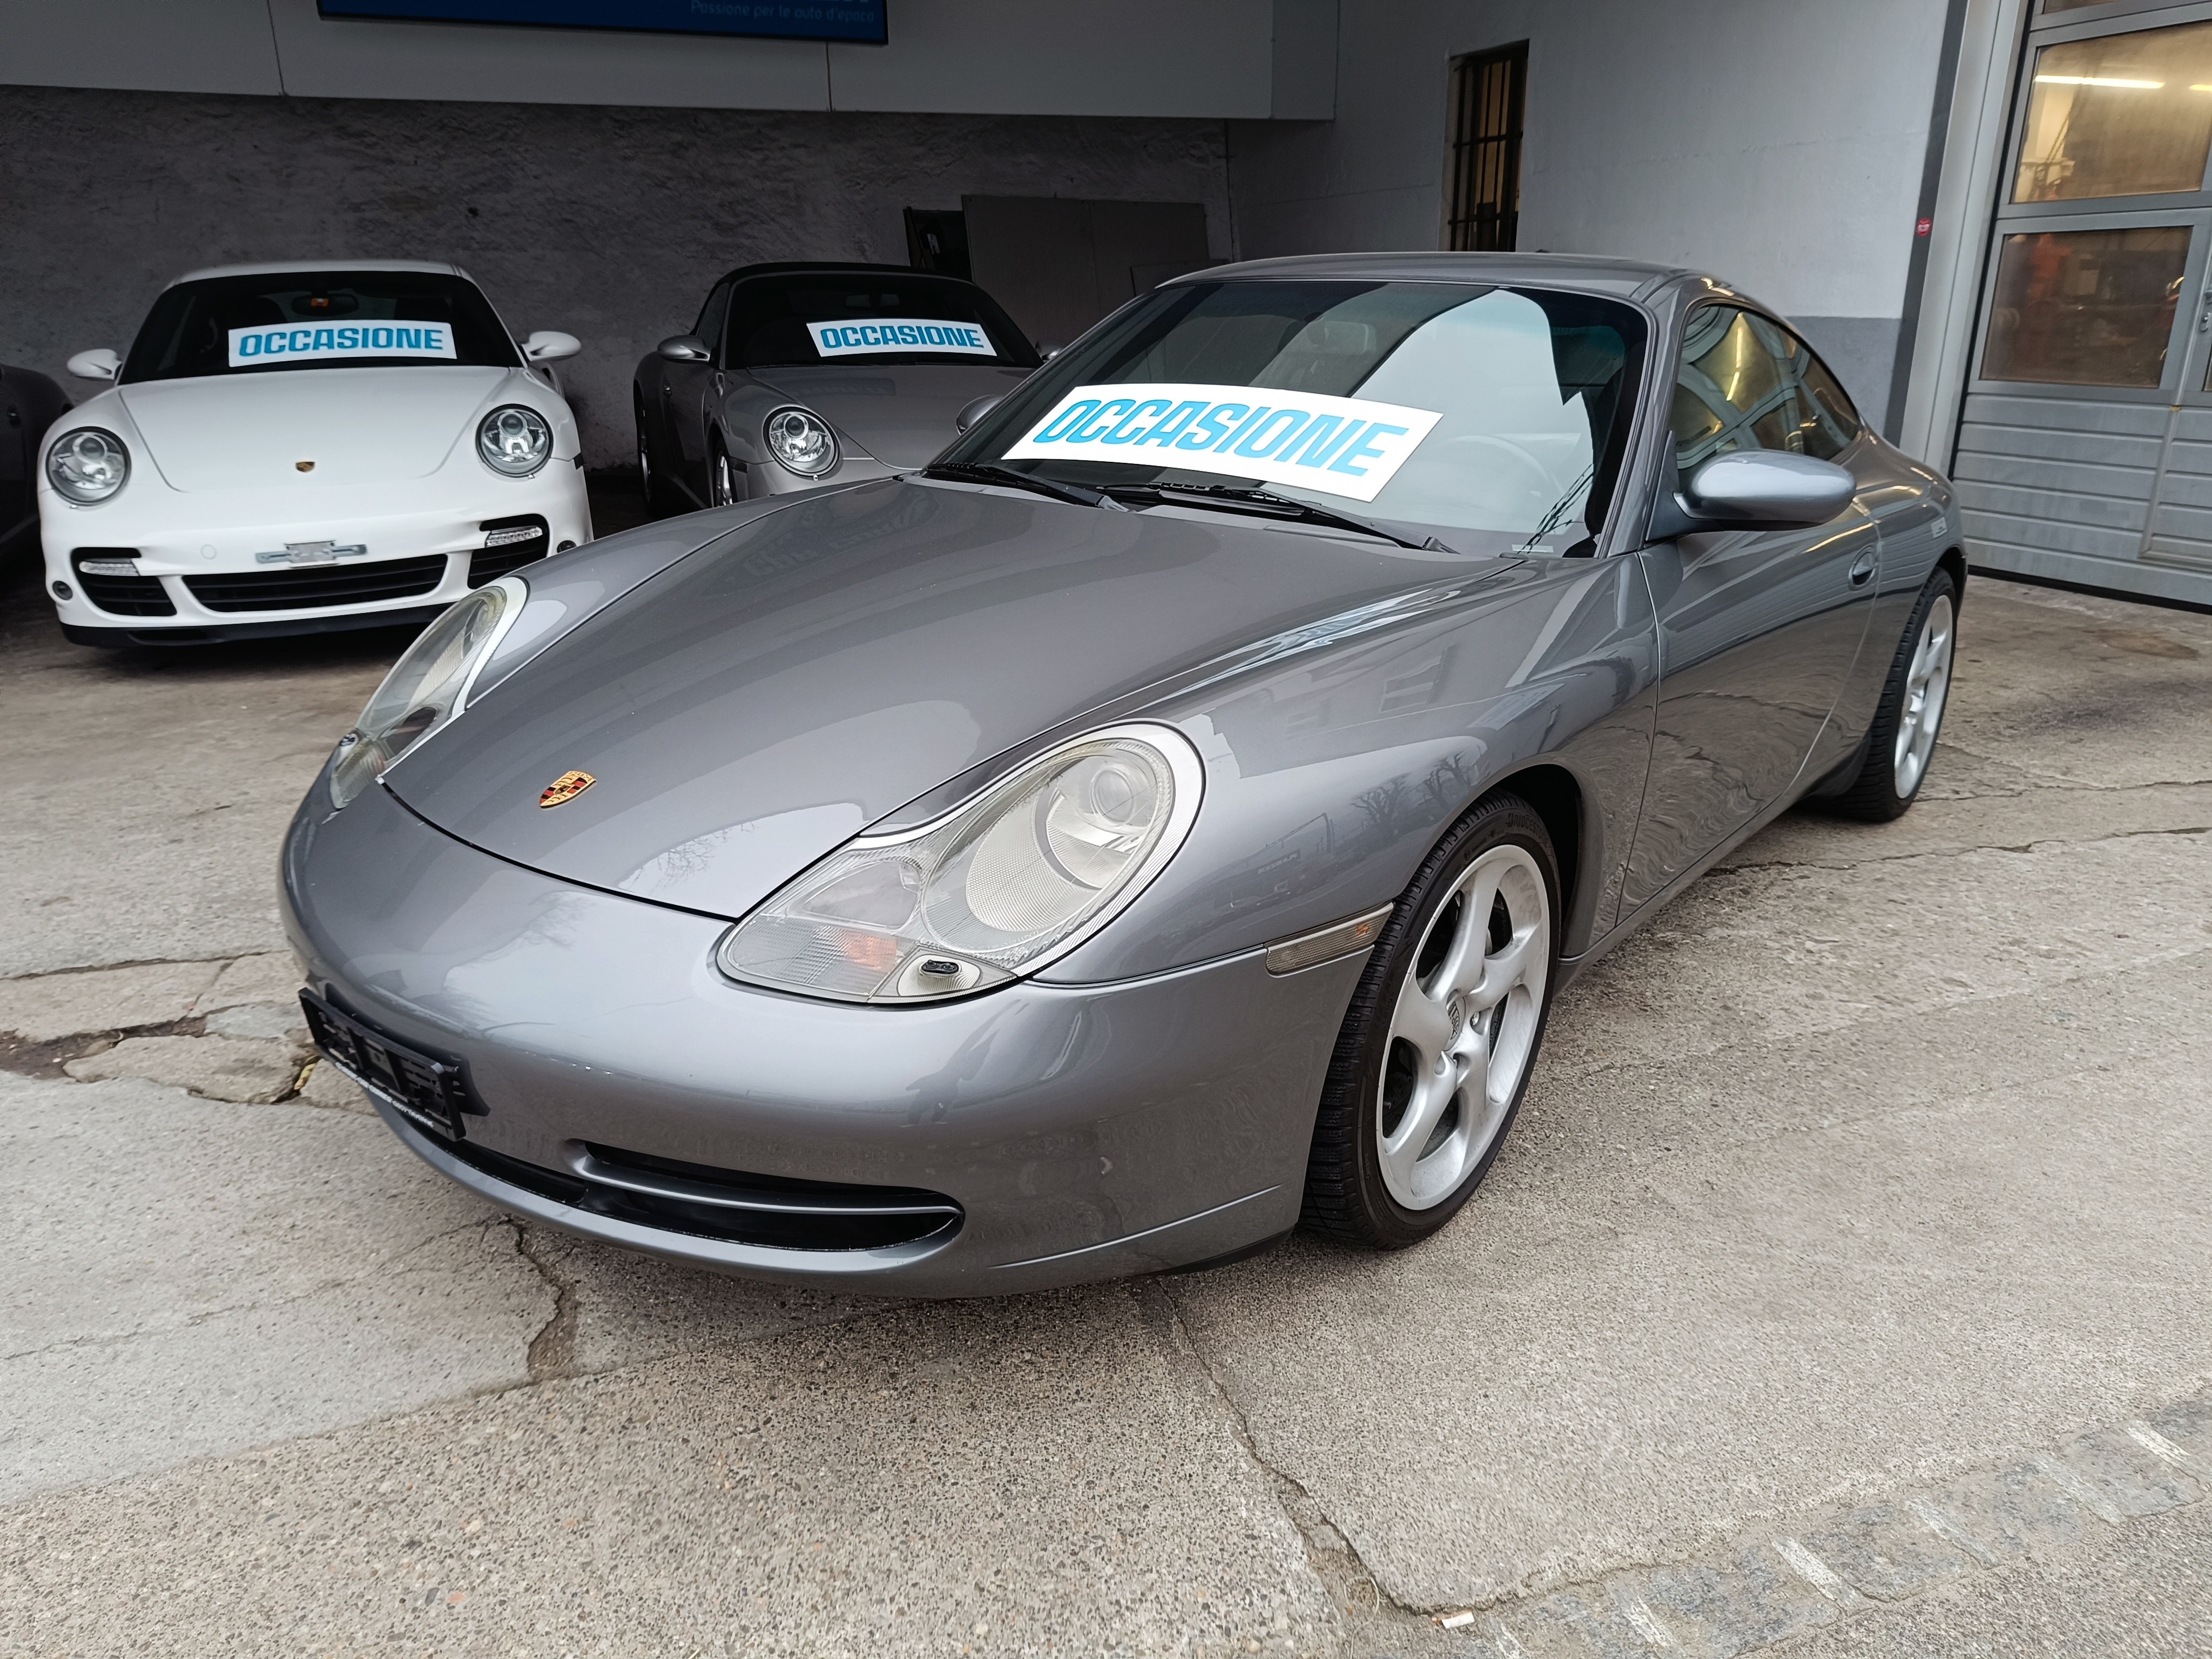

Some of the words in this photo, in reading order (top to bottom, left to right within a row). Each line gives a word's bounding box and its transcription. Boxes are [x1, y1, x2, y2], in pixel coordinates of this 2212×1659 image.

[691, 0, 750, 16] Passione
[754, 5, 774, 19] per
[779, 4, 791, 18] le
[794, 6, 822, 20] auto
[826, 7, 874, 23] d'epoca
[239, 327, 443, 356] OCCASIONE
[820, 325, 984, 349] OCCASIONE
[1033, 399, 1410, 477] OCCASIONE
